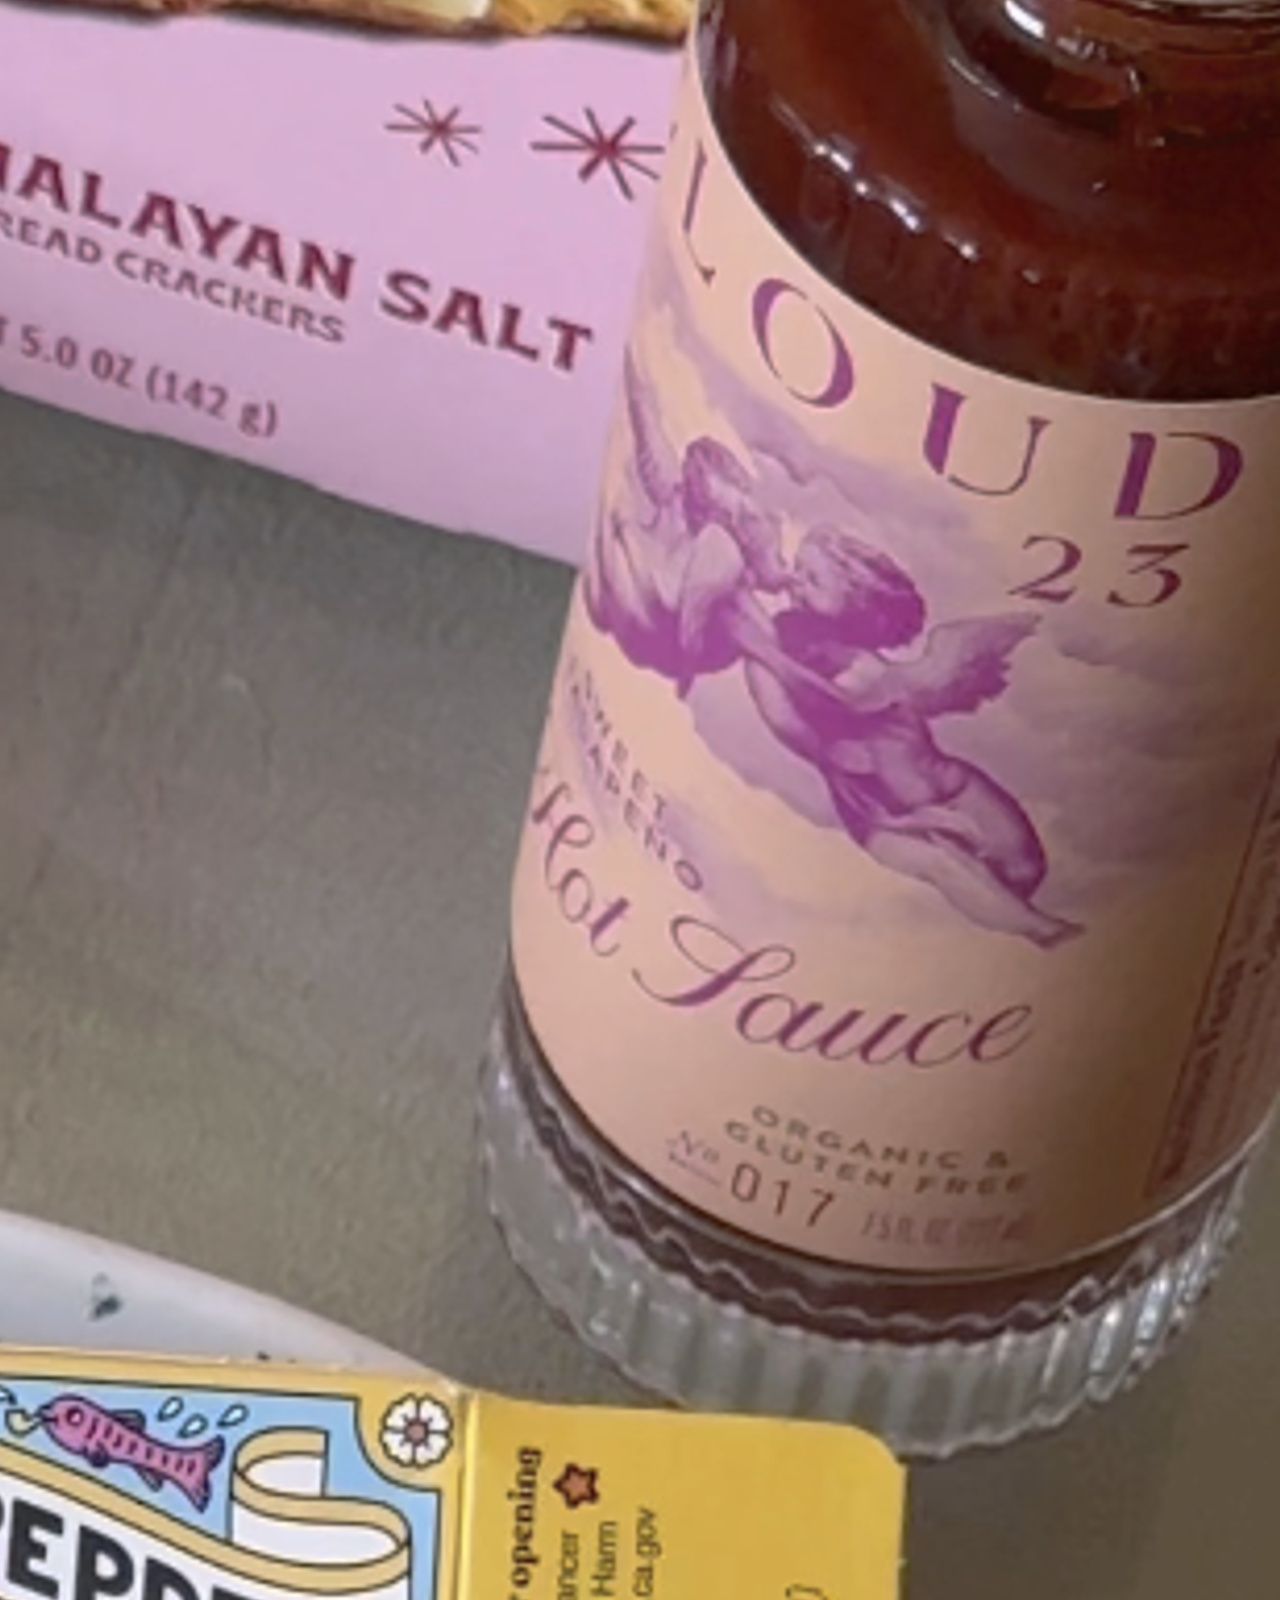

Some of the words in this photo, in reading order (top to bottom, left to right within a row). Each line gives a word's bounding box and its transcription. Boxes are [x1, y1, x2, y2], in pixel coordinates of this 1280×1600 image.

[116, 248, 346, 343] CRACKERS
[379, 269, 593, 373] SALT
[670, 122, 1244, 520] LOUD
[20, 325, 78, 370] 5.0
[91, 349, 136, 389] OZ
[145, 364, 230, 418] (142
[239, 401, 279, 439] g)
[1007, 536, 1190, 608] 23
[632, 914, 1033, 1068] Sauce
[726, 1119, 893, 1189] GLUTEN
[914, 1172, 1031, 1195] FREE
[752, 1104, 962, 1170] ORGANIC
[731, 1162, 834, 1229] 017
[507, 1446, 543, 1590] opening
[591, 1520, 619, 1598] Harm
